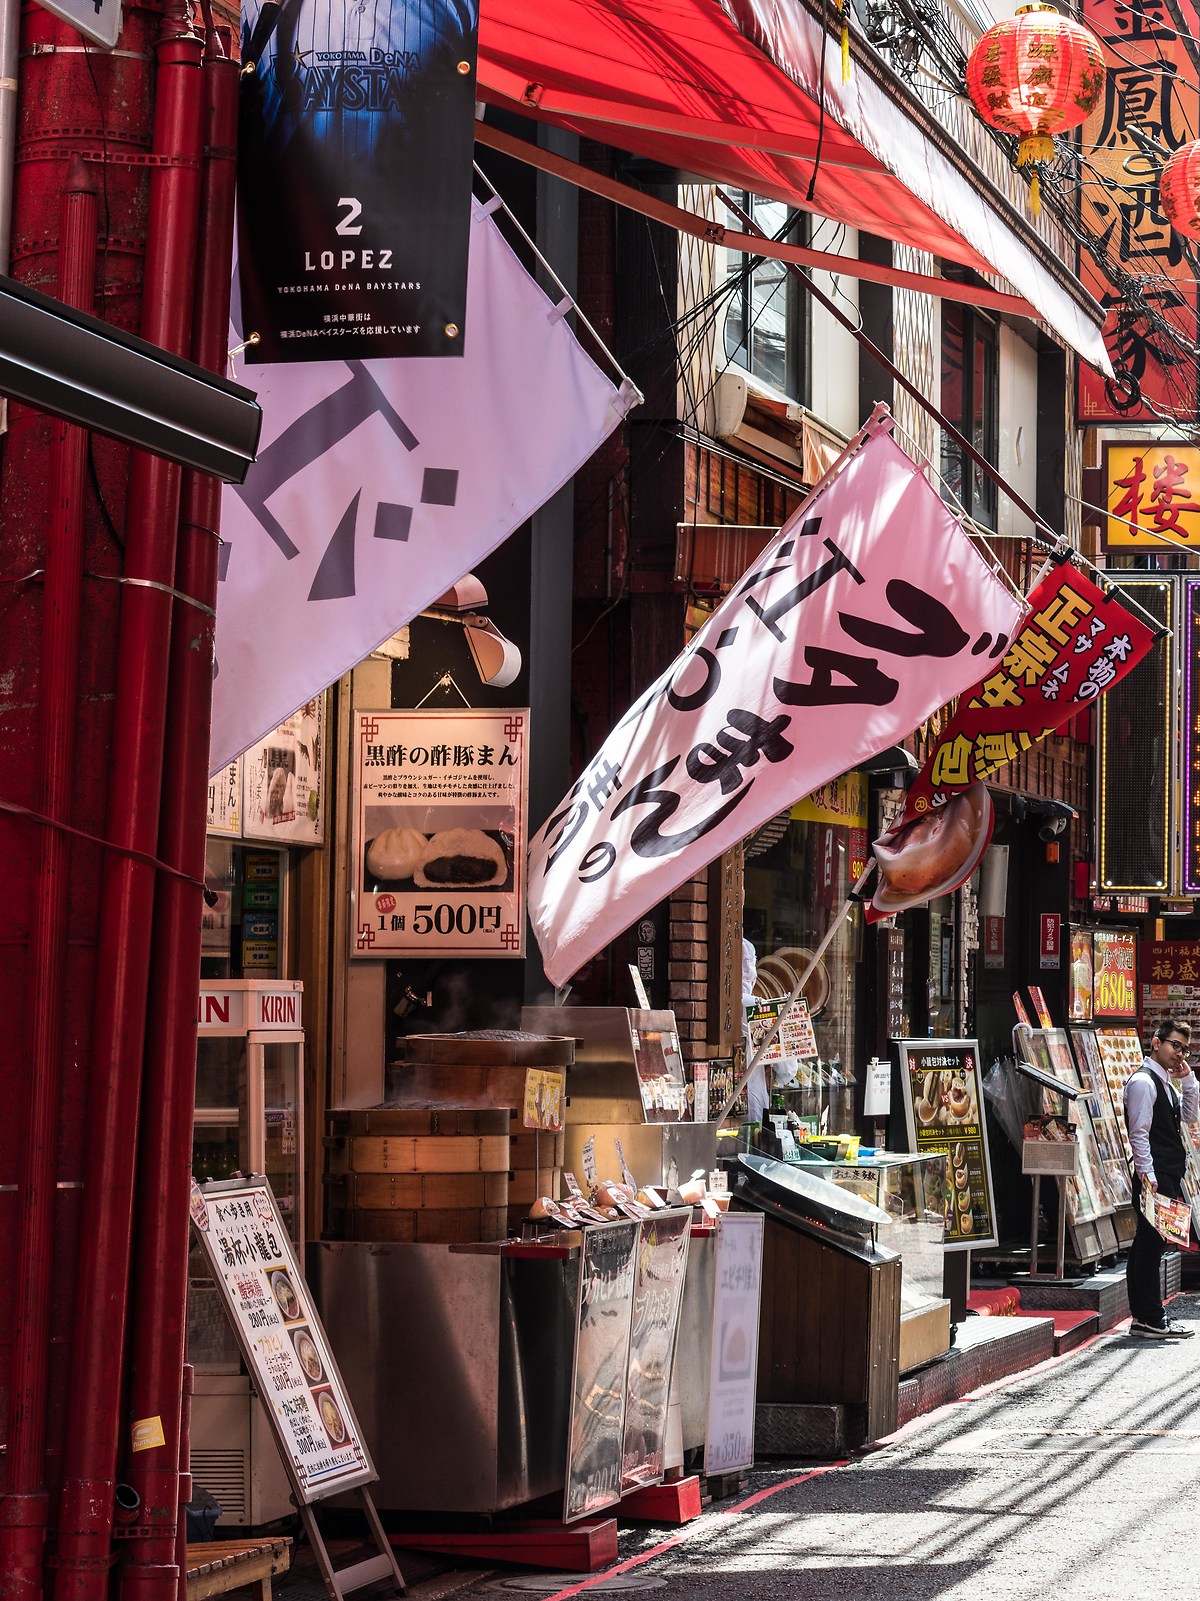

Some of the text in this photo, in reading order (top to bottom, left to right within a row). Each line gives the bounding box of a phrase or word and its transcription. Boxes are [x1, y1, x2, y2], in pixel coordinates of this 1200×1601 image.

[335, 198, 363, 236] 2
[304, 250, 394, 271] LOPEZ
[277, 281, 422, 294] YOKOHAMA DeNA BAYSTARS
[323, 313, 372, 323] 横浜中華街は
[1078, 634, 1134, 700] 本物の
[364, 744, 518, 767] 黒酢の酢豚まん
[377, 903, 502, 935] 1個 500円
[261, 995, 295, 1023] KIRIN
